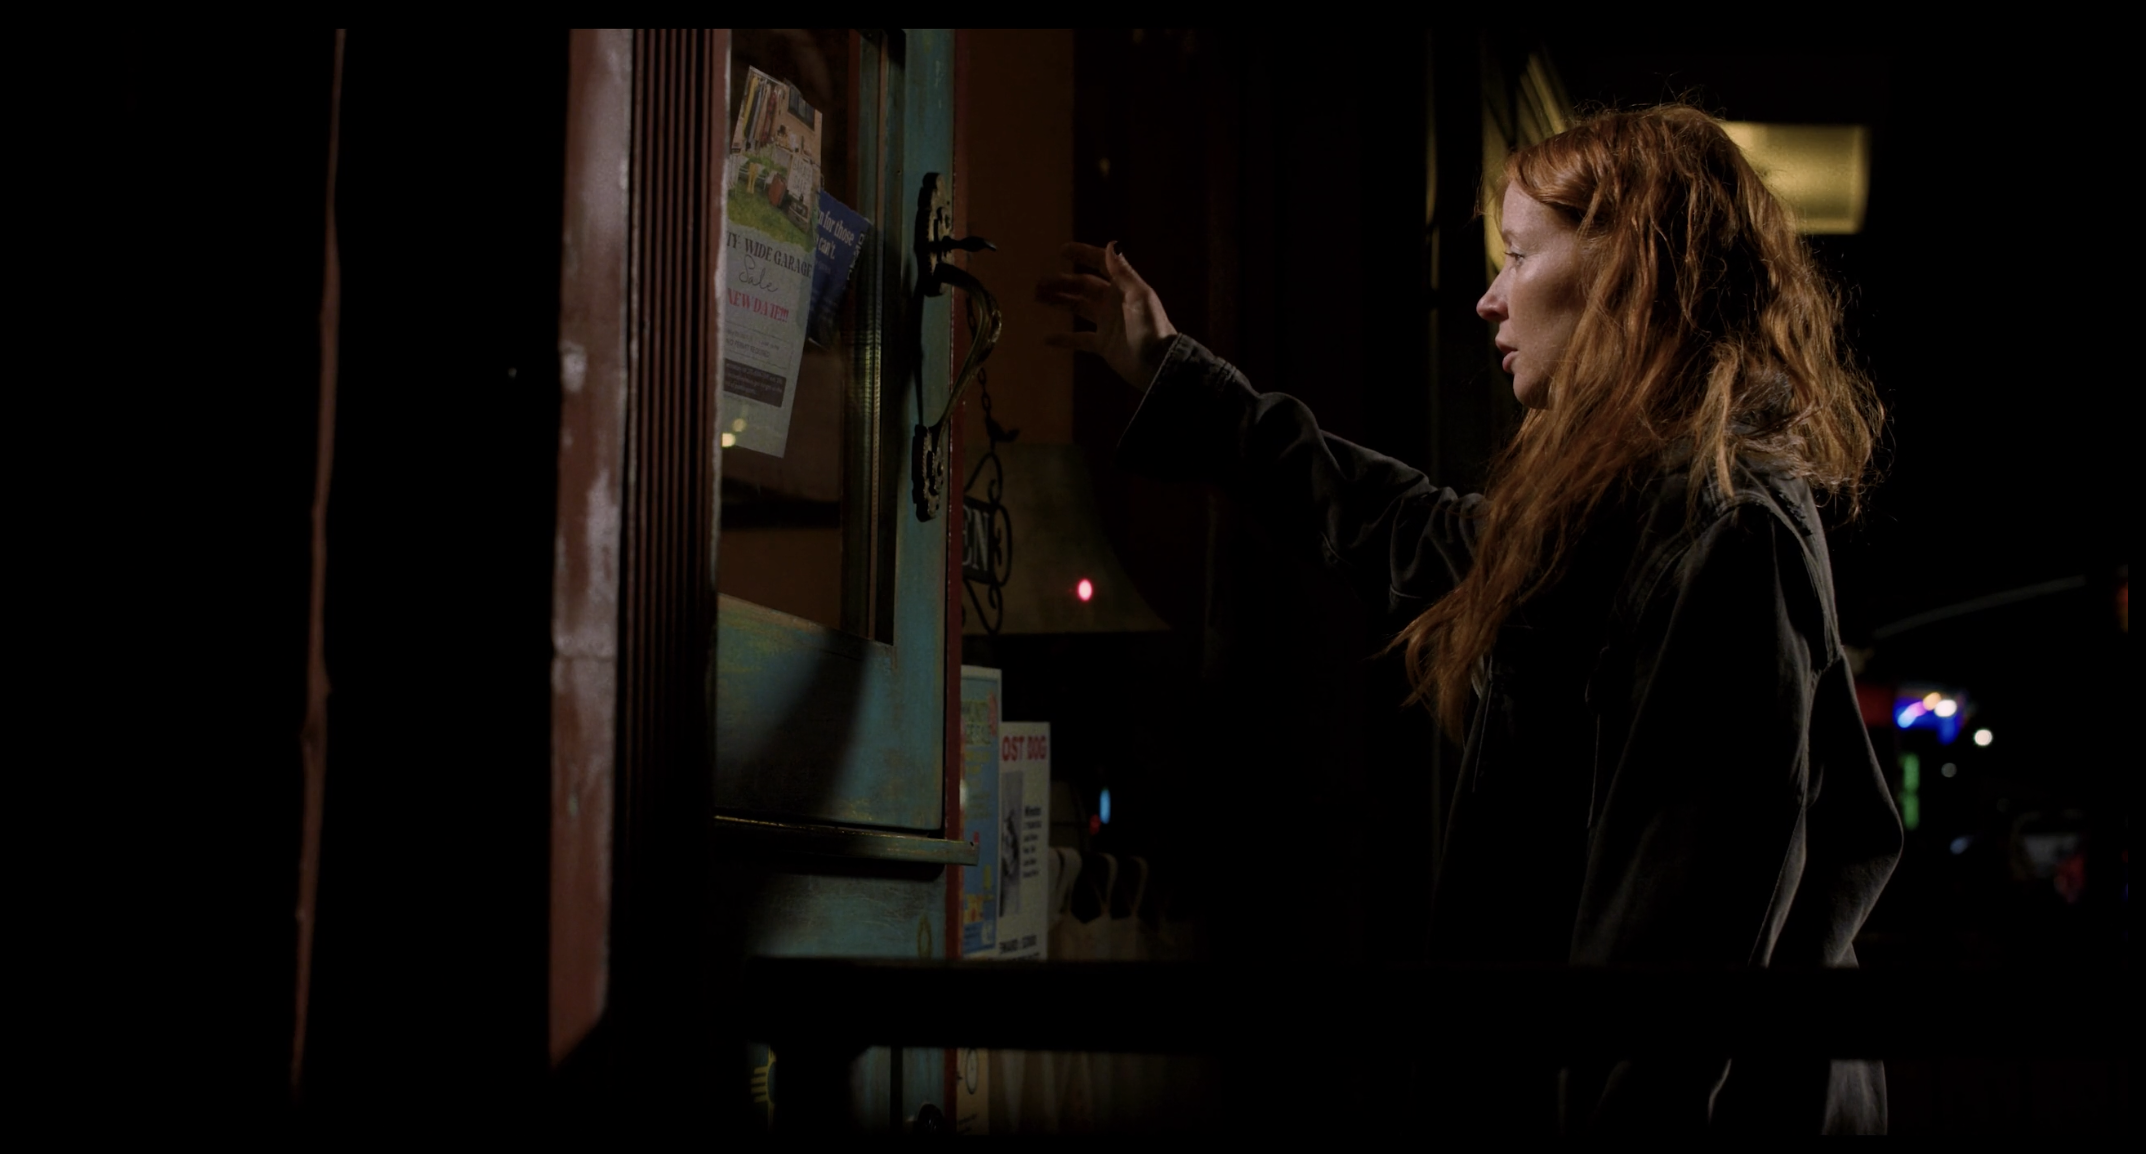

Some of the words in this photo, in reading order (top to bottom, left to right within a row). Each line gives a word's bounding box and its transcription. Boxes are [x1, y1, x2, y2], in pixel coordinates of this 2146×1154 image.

[823, 210, 836, 233] for
[834, 219, 855, 247] those
[739, 254, 778, 293] Sale
[774, 250, 812, 278] GARAGE
[727, 287, 751, 309] NEW
[1002, 735, 1025, 761] OST
